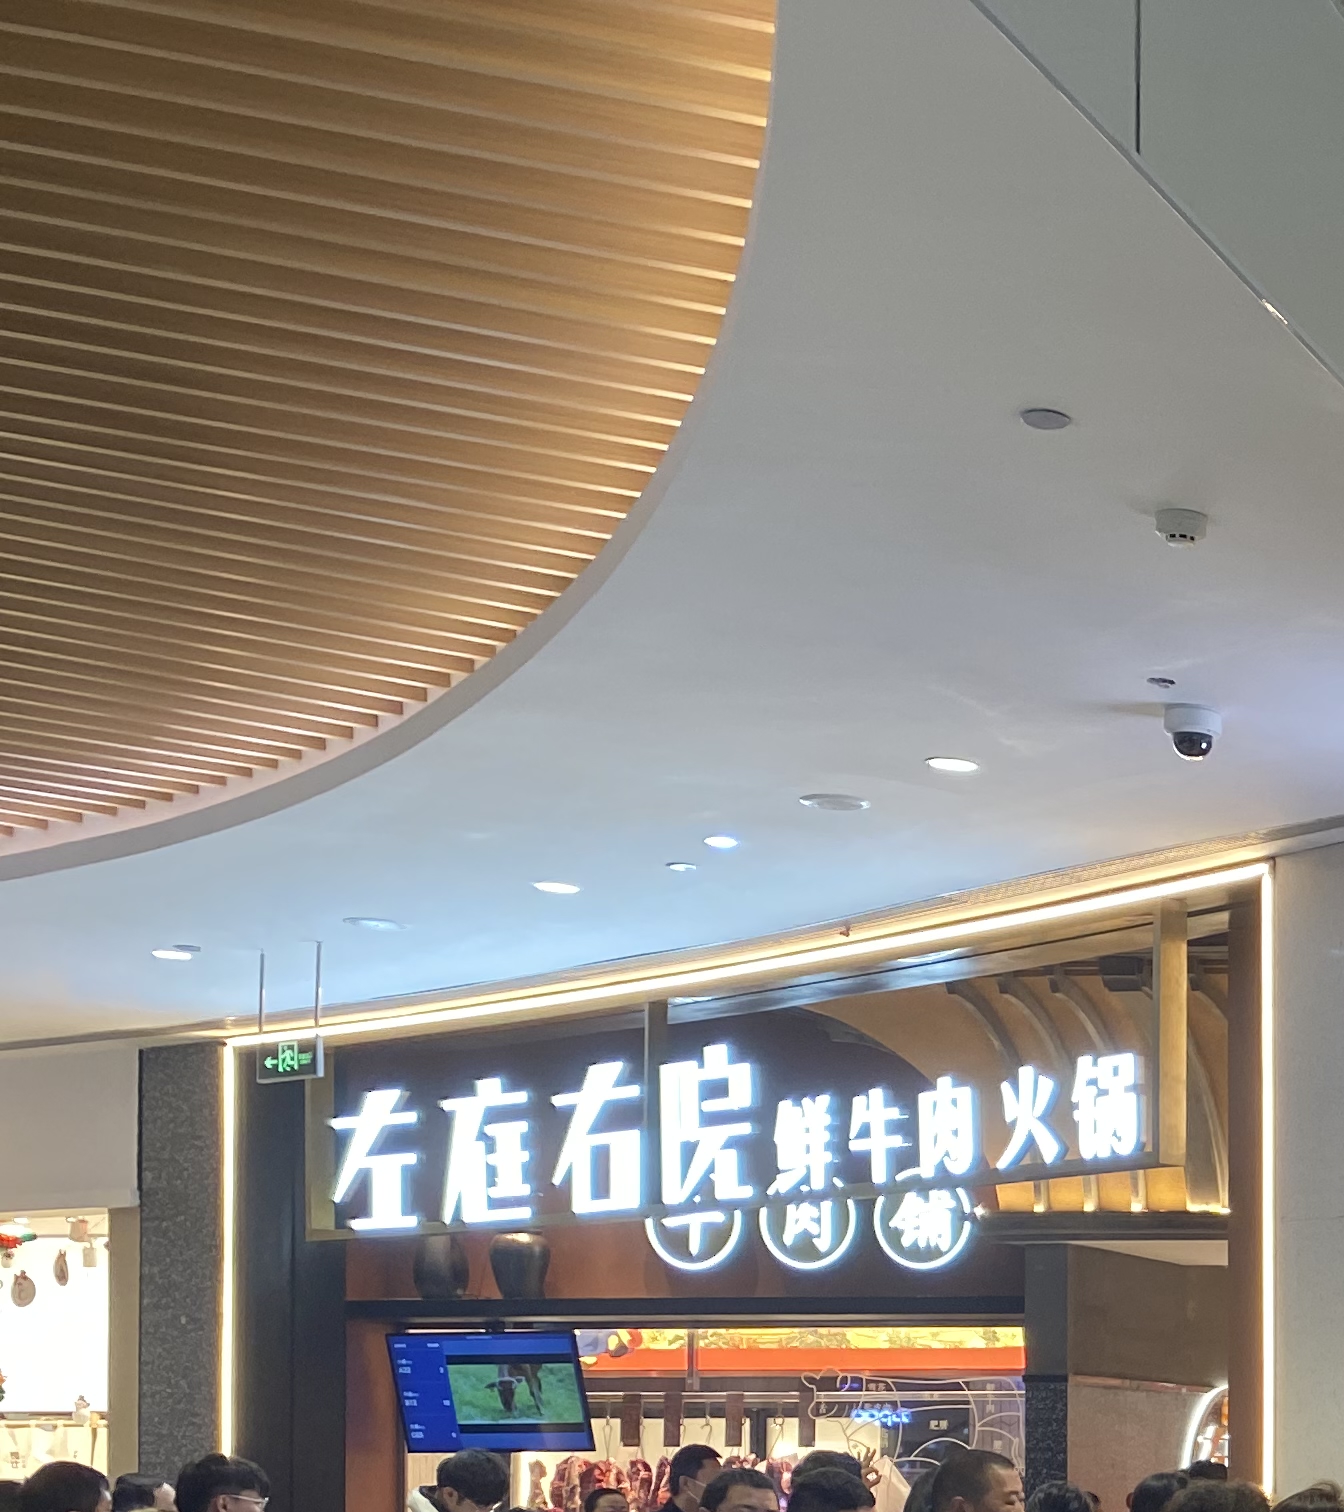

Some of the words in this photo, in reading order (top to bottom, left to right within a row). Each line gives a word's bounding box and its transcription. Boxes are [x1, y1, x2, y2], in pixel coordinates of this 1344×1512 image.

[328, 1043, 756, 1231] 左庭右院
[767, 1052, 1147, 1197] 鲜牛肉火锅
